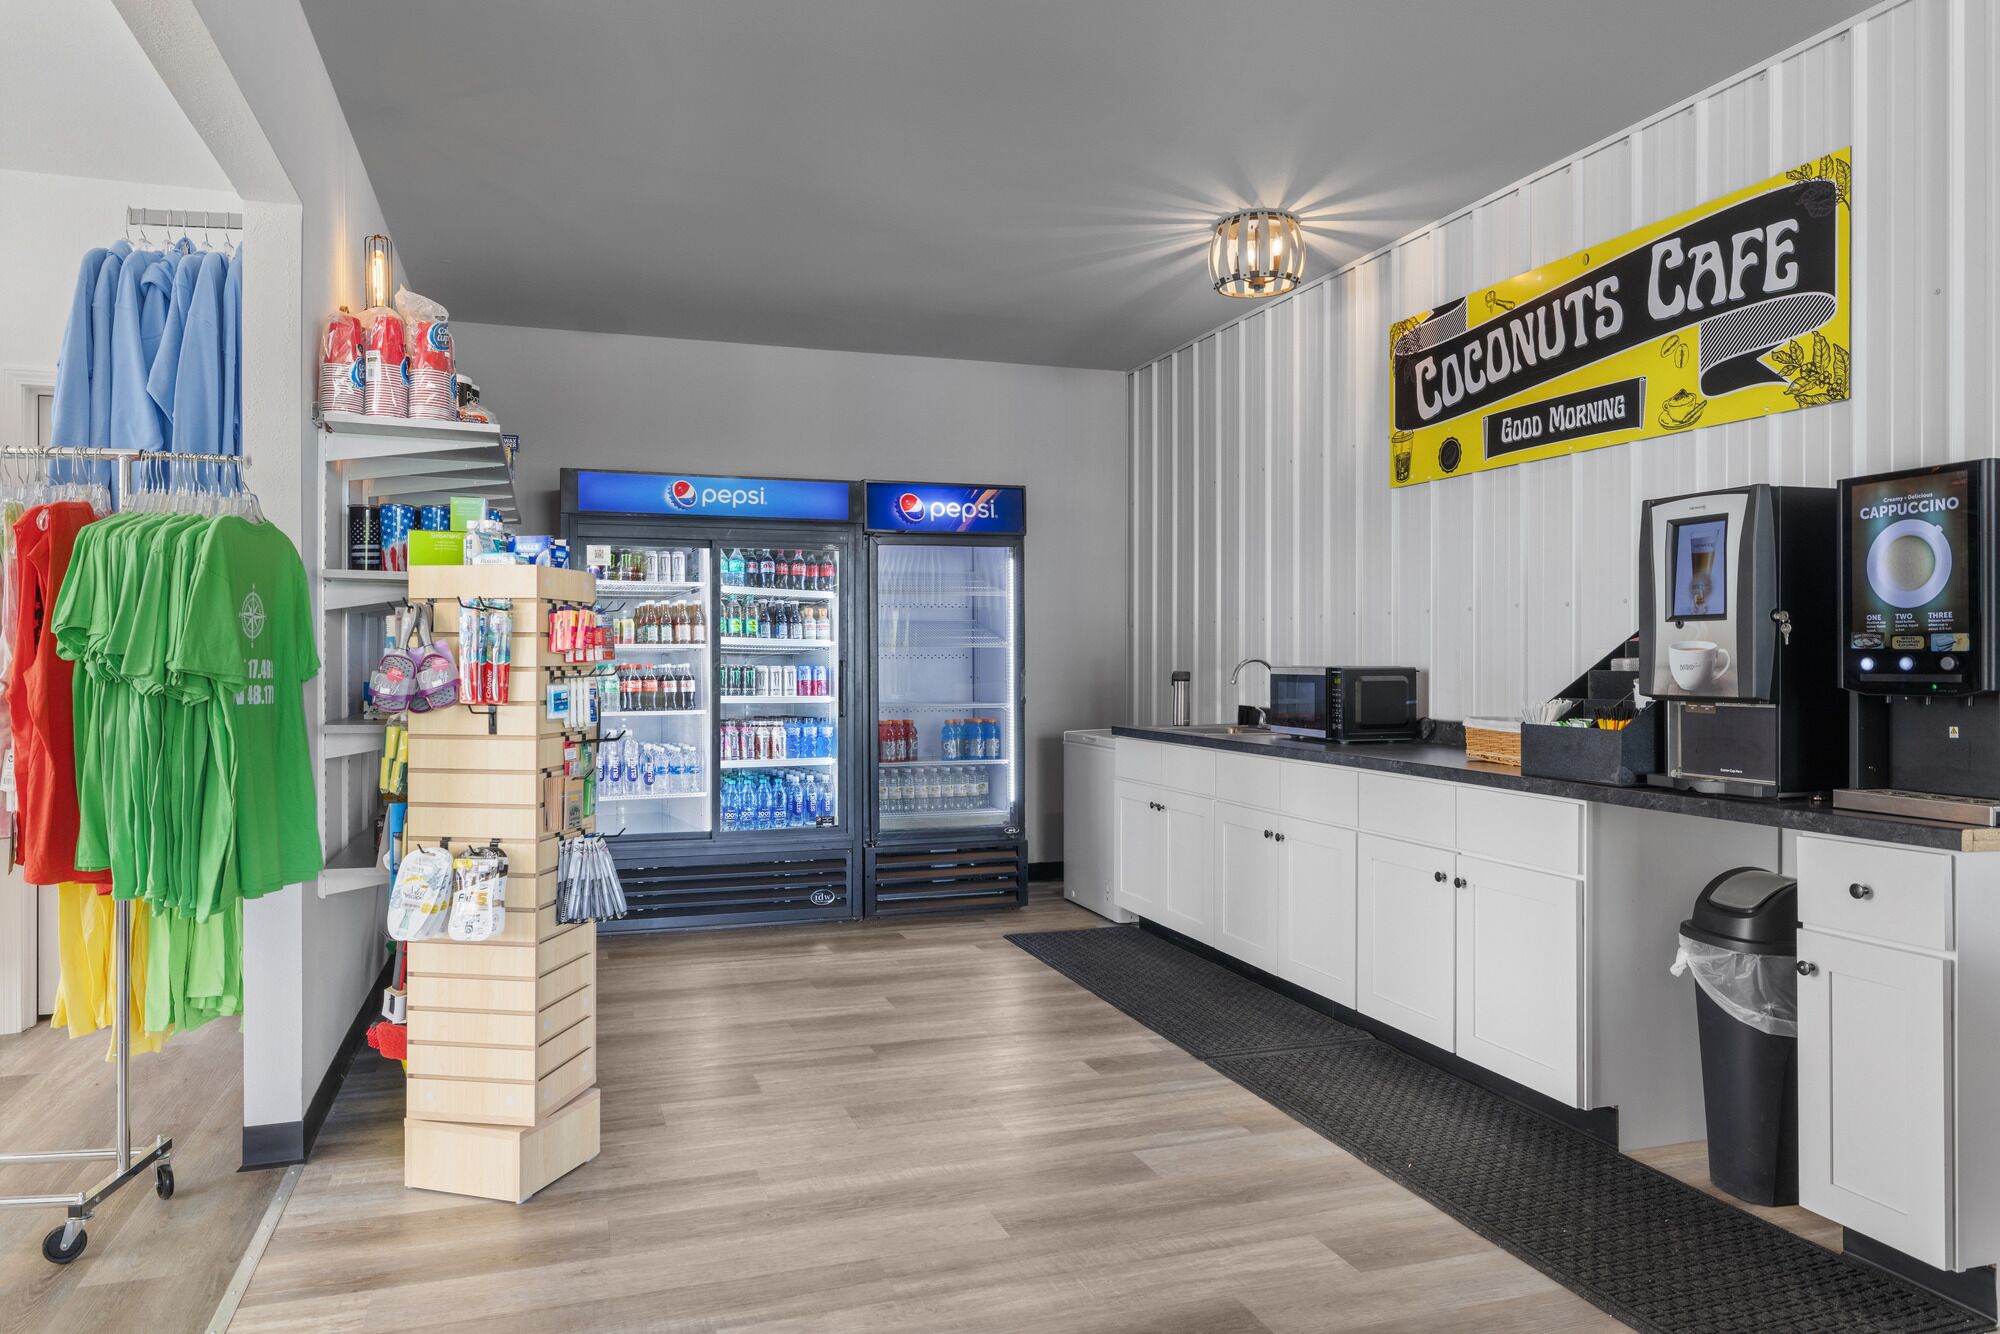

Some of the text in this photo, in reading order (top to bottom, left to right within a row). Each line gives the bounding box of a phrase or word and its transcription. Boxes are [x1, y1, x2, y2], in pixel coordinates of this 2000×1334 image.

[1414, 218, 1799, 421] COCONUTS CAFE
[1501, 395, 1626, 444] GOOD MORNING
[702, 486, 765, 508] pepsi
[1860, 497, 1959, 520] CAPPUCCINO
[931, 499, 996, 522] pepsi
[1928, 611, 1953, 619] THREE
